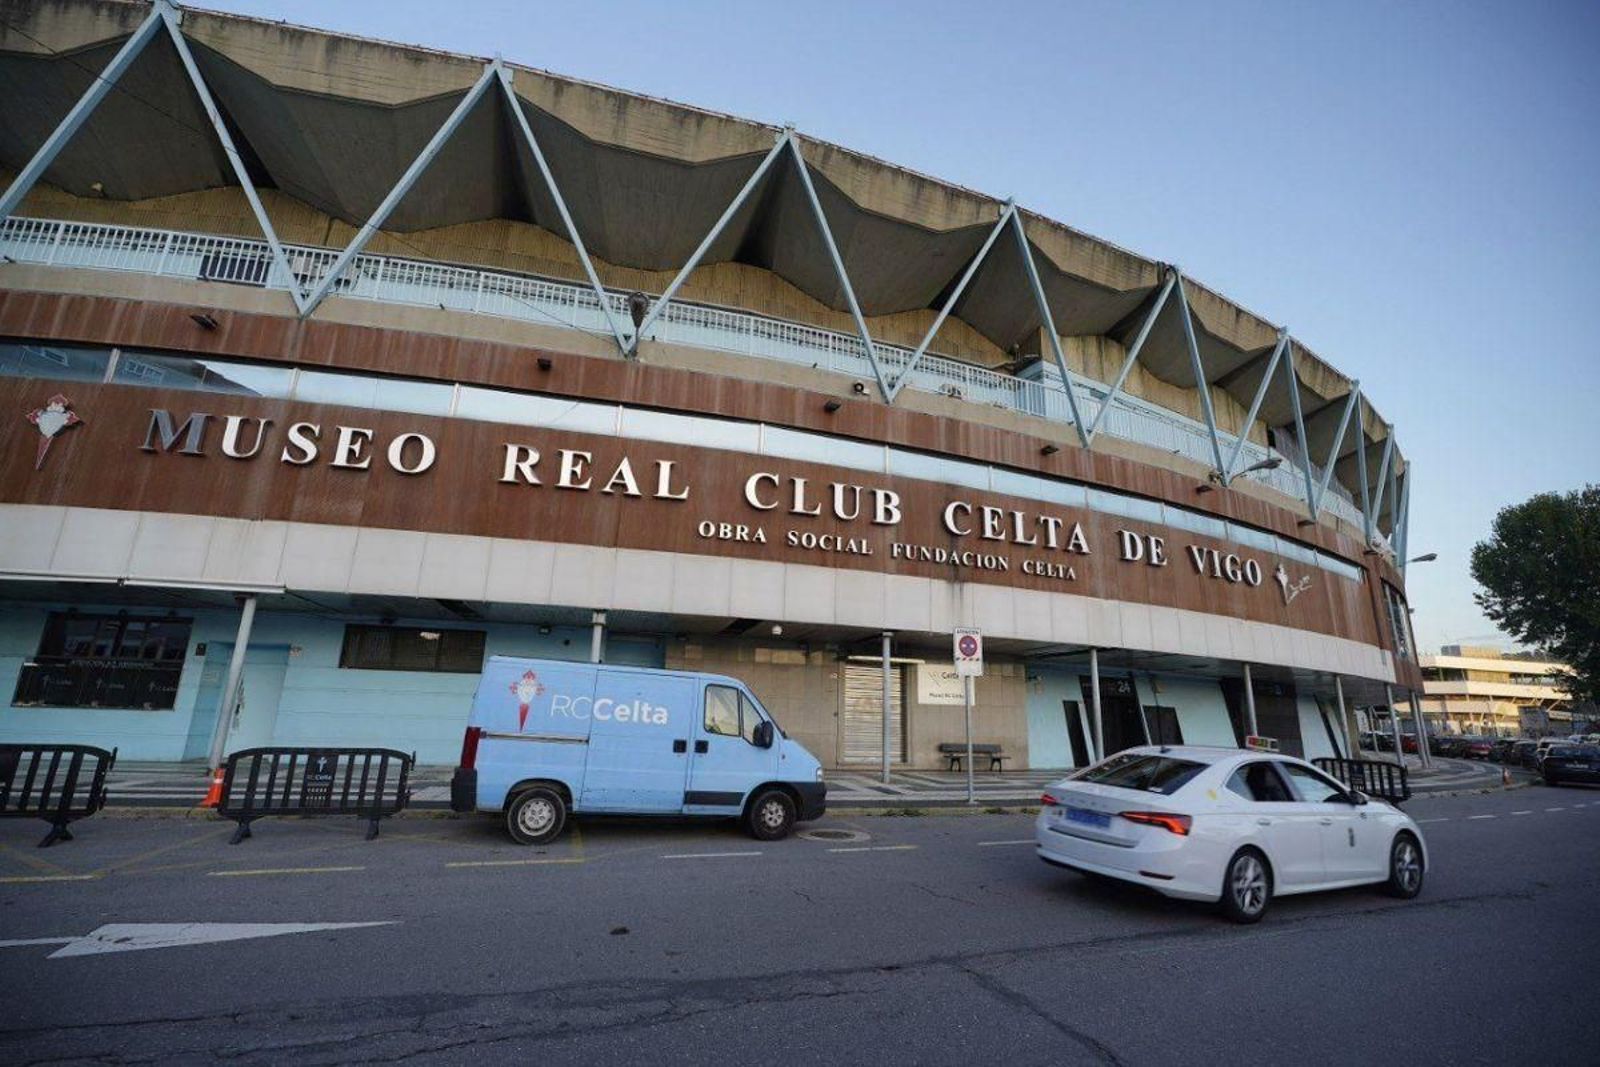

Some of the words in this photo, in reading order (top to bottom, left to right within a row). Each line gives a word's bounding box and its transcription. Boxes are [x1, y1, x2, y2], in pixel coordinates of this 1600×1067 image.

[139, 408, 437, 474] MUSEO
[499, 442, 691, 500] REAL
[743, 471, 903, 526] CLUB
[943, 500, 1093, 555] CELTA
[1119, 529, 1168, 567] DE
[1188, 544, 1263, 588] VIGO
[697, 520, 767, 544] OBRA
[787, 530, 873, 556] SOCIAL
[891, 542, 1010, 571] FUNDACION
[1022, 558, 1077, 581] CELTA
[550, 695, 669, 724] RCCelta
